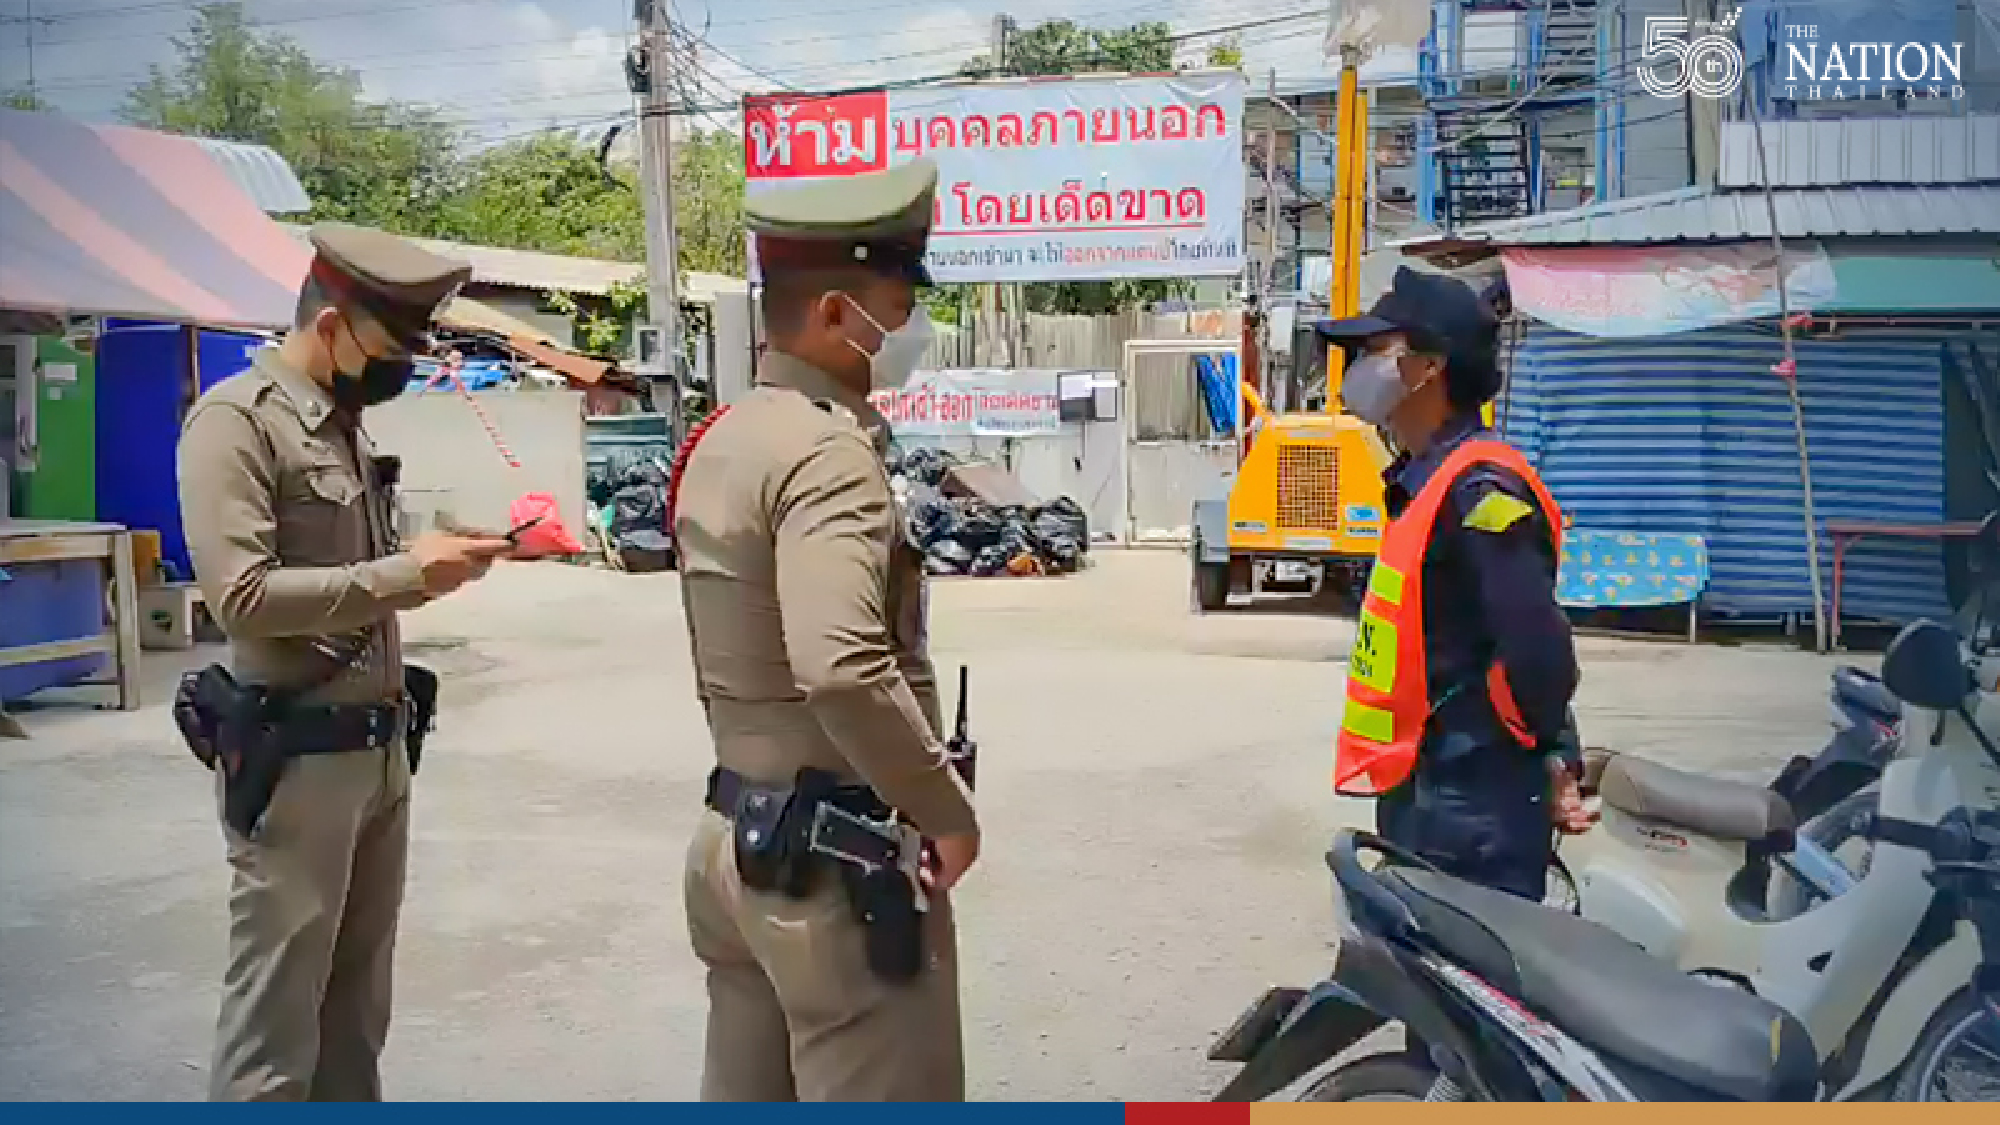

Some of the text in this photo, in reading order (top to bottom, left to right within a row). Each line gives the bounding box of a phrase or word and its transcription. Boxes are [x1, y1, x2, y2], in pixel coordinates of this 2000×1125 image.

[748, 103, 876, 168] ห้าม
[951, 178, 1207, 226] โดยเด็ดขาด
